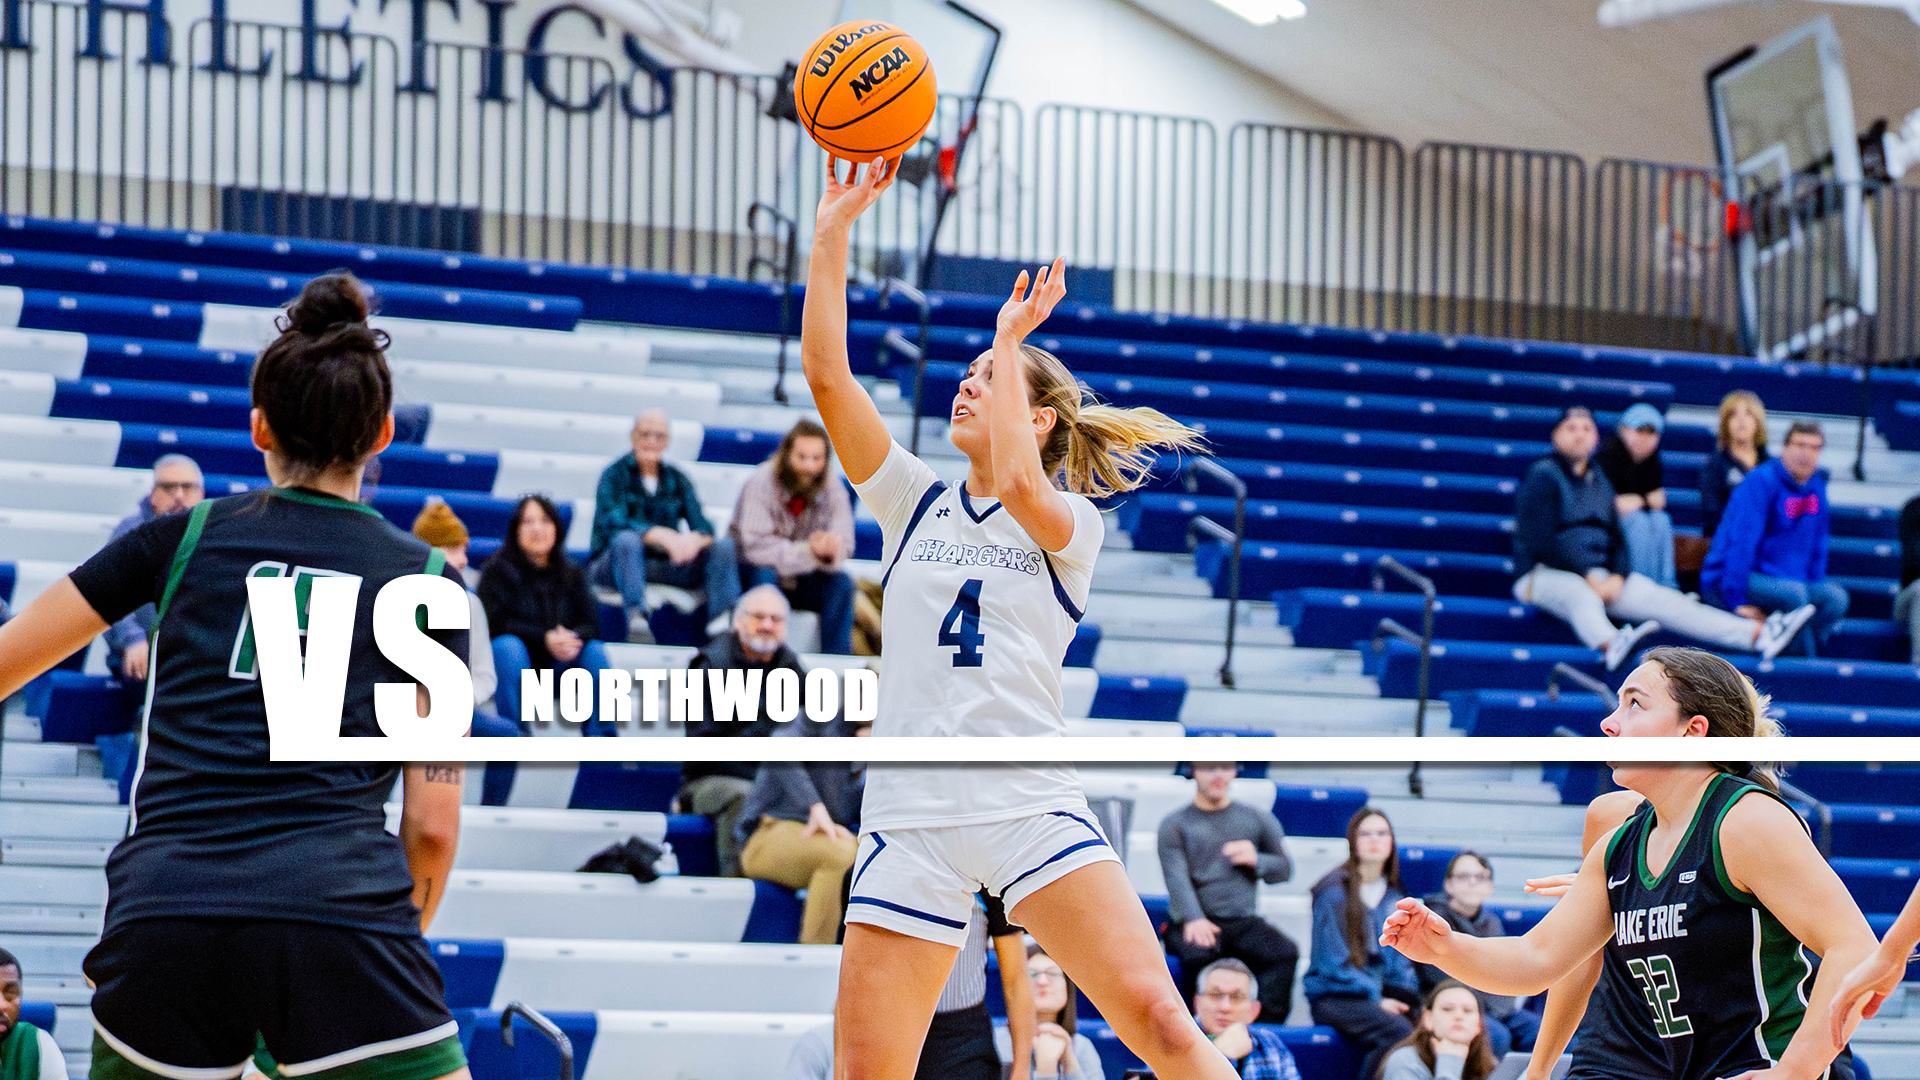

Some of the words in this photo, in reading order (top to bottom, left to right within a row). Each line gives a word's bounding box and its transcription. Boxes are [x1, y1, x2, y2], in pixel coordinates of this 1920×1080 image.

[810, 23, 891, 77] Wilson
[849, 46, 911, 101] NCAA
[911, 539, 1041, 576] CHARGERS
[938, 578, 985, 667] 4
[1648, 903, 1688, 941] ERIE
[1626, 954, 1694, 1038] 32
